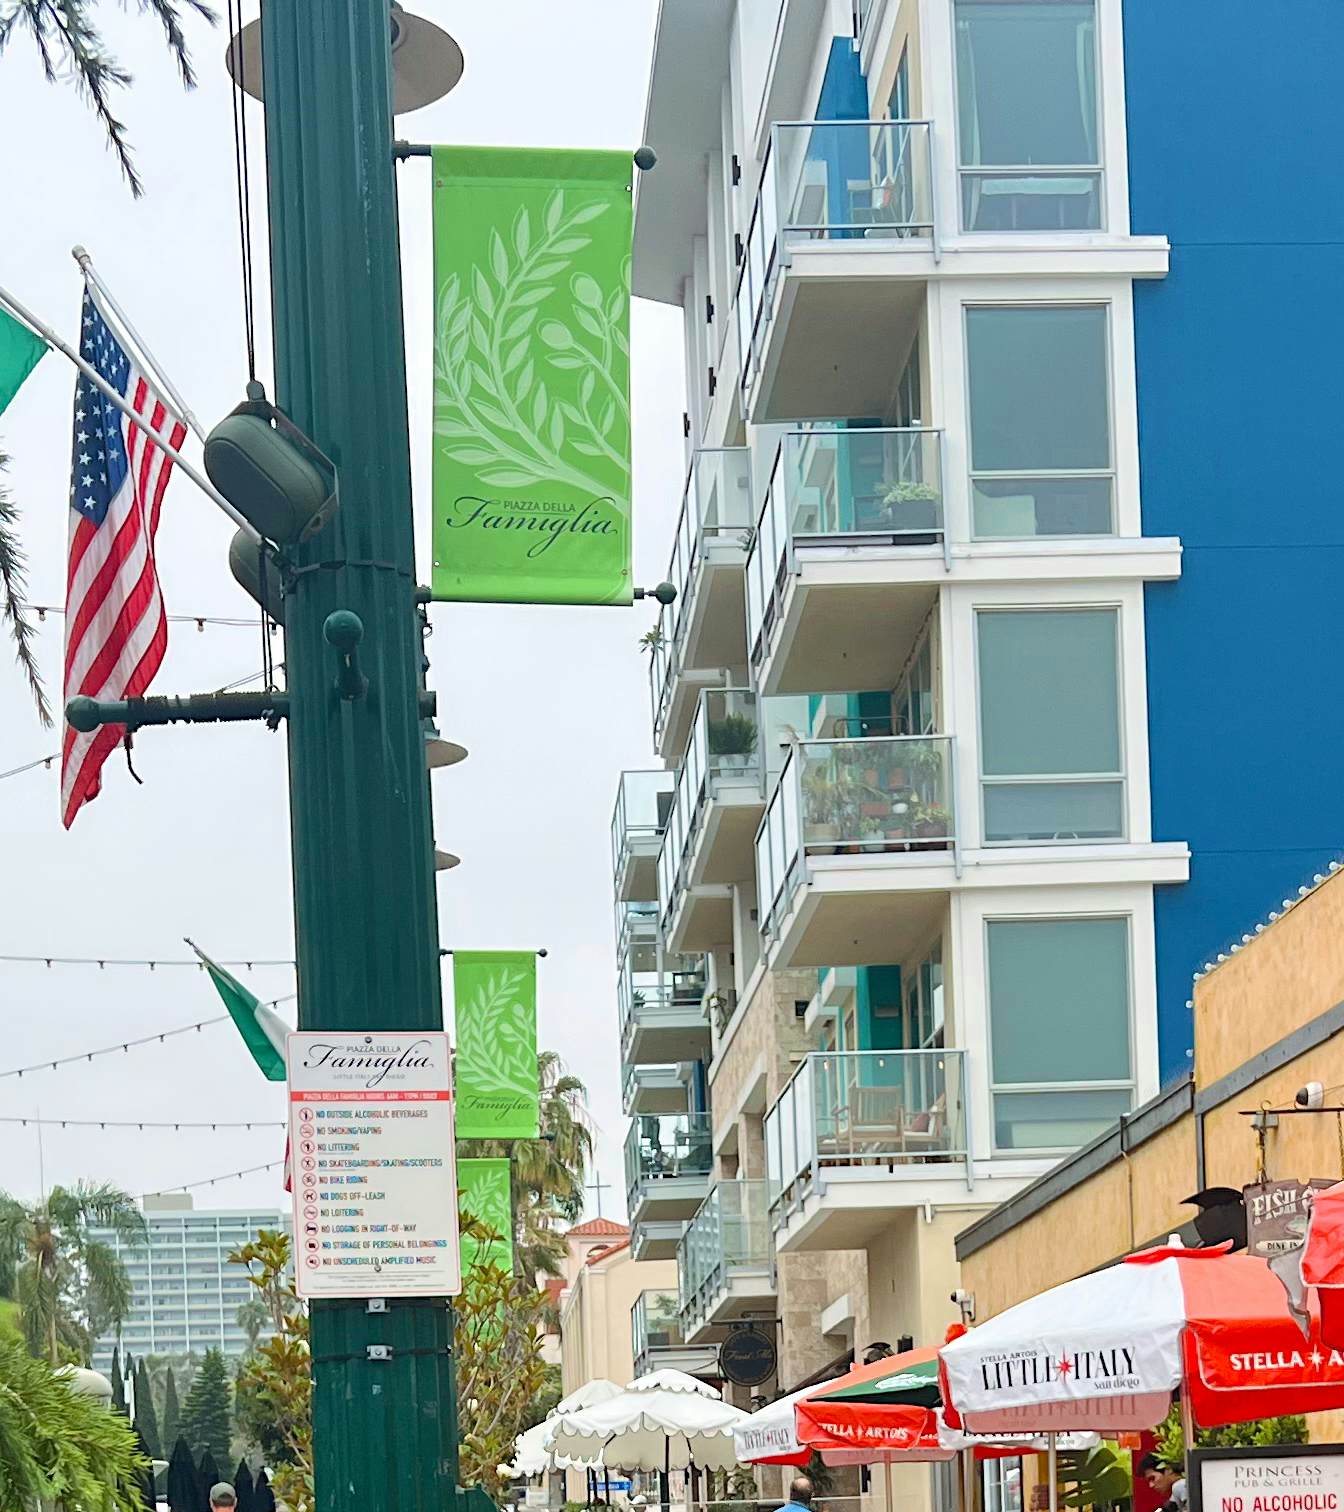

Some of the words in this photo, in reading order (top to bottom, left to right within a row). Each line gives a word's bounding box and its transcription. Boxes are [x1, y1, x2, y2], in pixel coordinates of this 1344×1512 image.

[504, 500, 540, 511] PIAZZA
[543, 501, 577, 513] DELLA
[446, 496, 618, 558] Famiglia
[303, 1039, 434, 1088] Famiglia
[1253, 1188, 1296, 1224] FISH
[980, 1353, 1007, 1363] STELLA
[1009, 1350, 1038, 1360] ARTOIS
[1230, 1350, 1305, 1371] STELLA
[981, 1355, 1057, 1391] LITTLE
[1074, 1345, 1136, 1380] ITALY
[1113, 1377, 1140, 1391] diego
[865, 1426, 909, 1440] ARTOIS
[1234, 1464, 1323, 1478] PRINCESS
[1234, 1479, 1259, 1488] PUB
[1278, 1477, 1322, 1487] GRILLE
[1252, 1493, 1338, 1512] ALCOHOLIC
